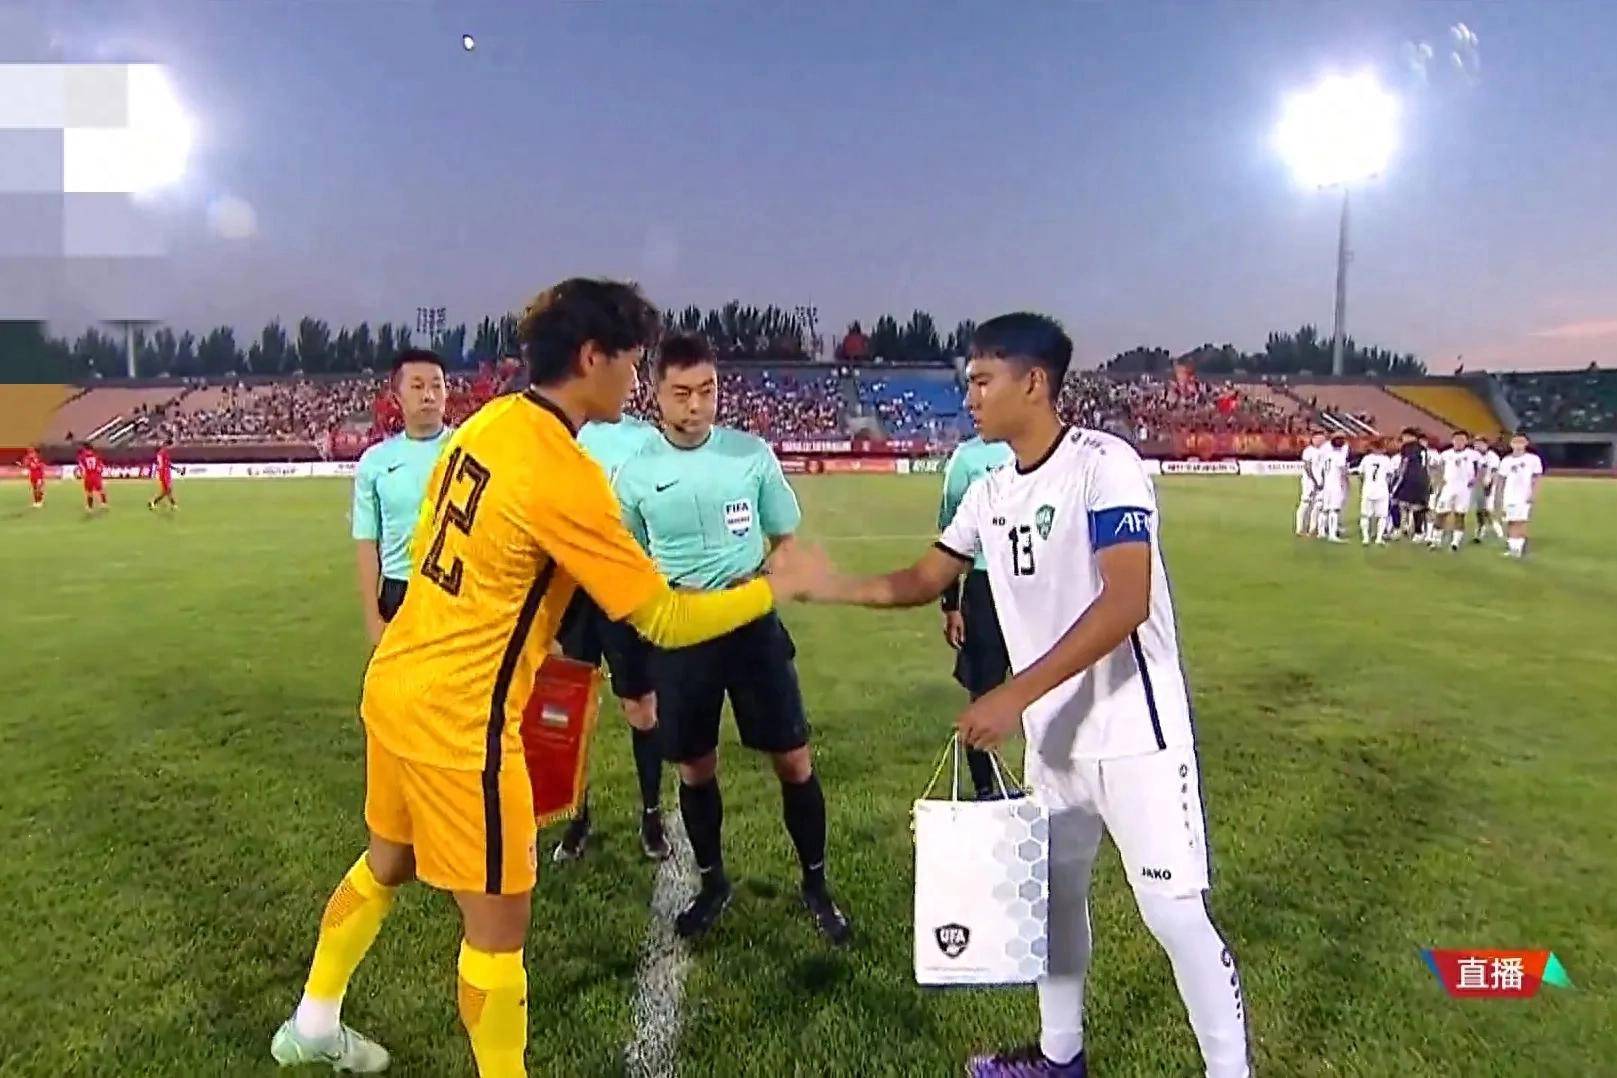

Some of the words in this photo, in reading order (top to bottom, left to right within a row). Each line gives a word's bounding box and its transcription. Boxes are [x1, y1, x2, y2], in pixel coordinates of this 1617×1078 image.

[1371, 463, 1381, 482] 7
[421, 446, 491, 597] 12
[726, 502, 749, 515] FIFA
[1008, 525, 1035, 576] 13
